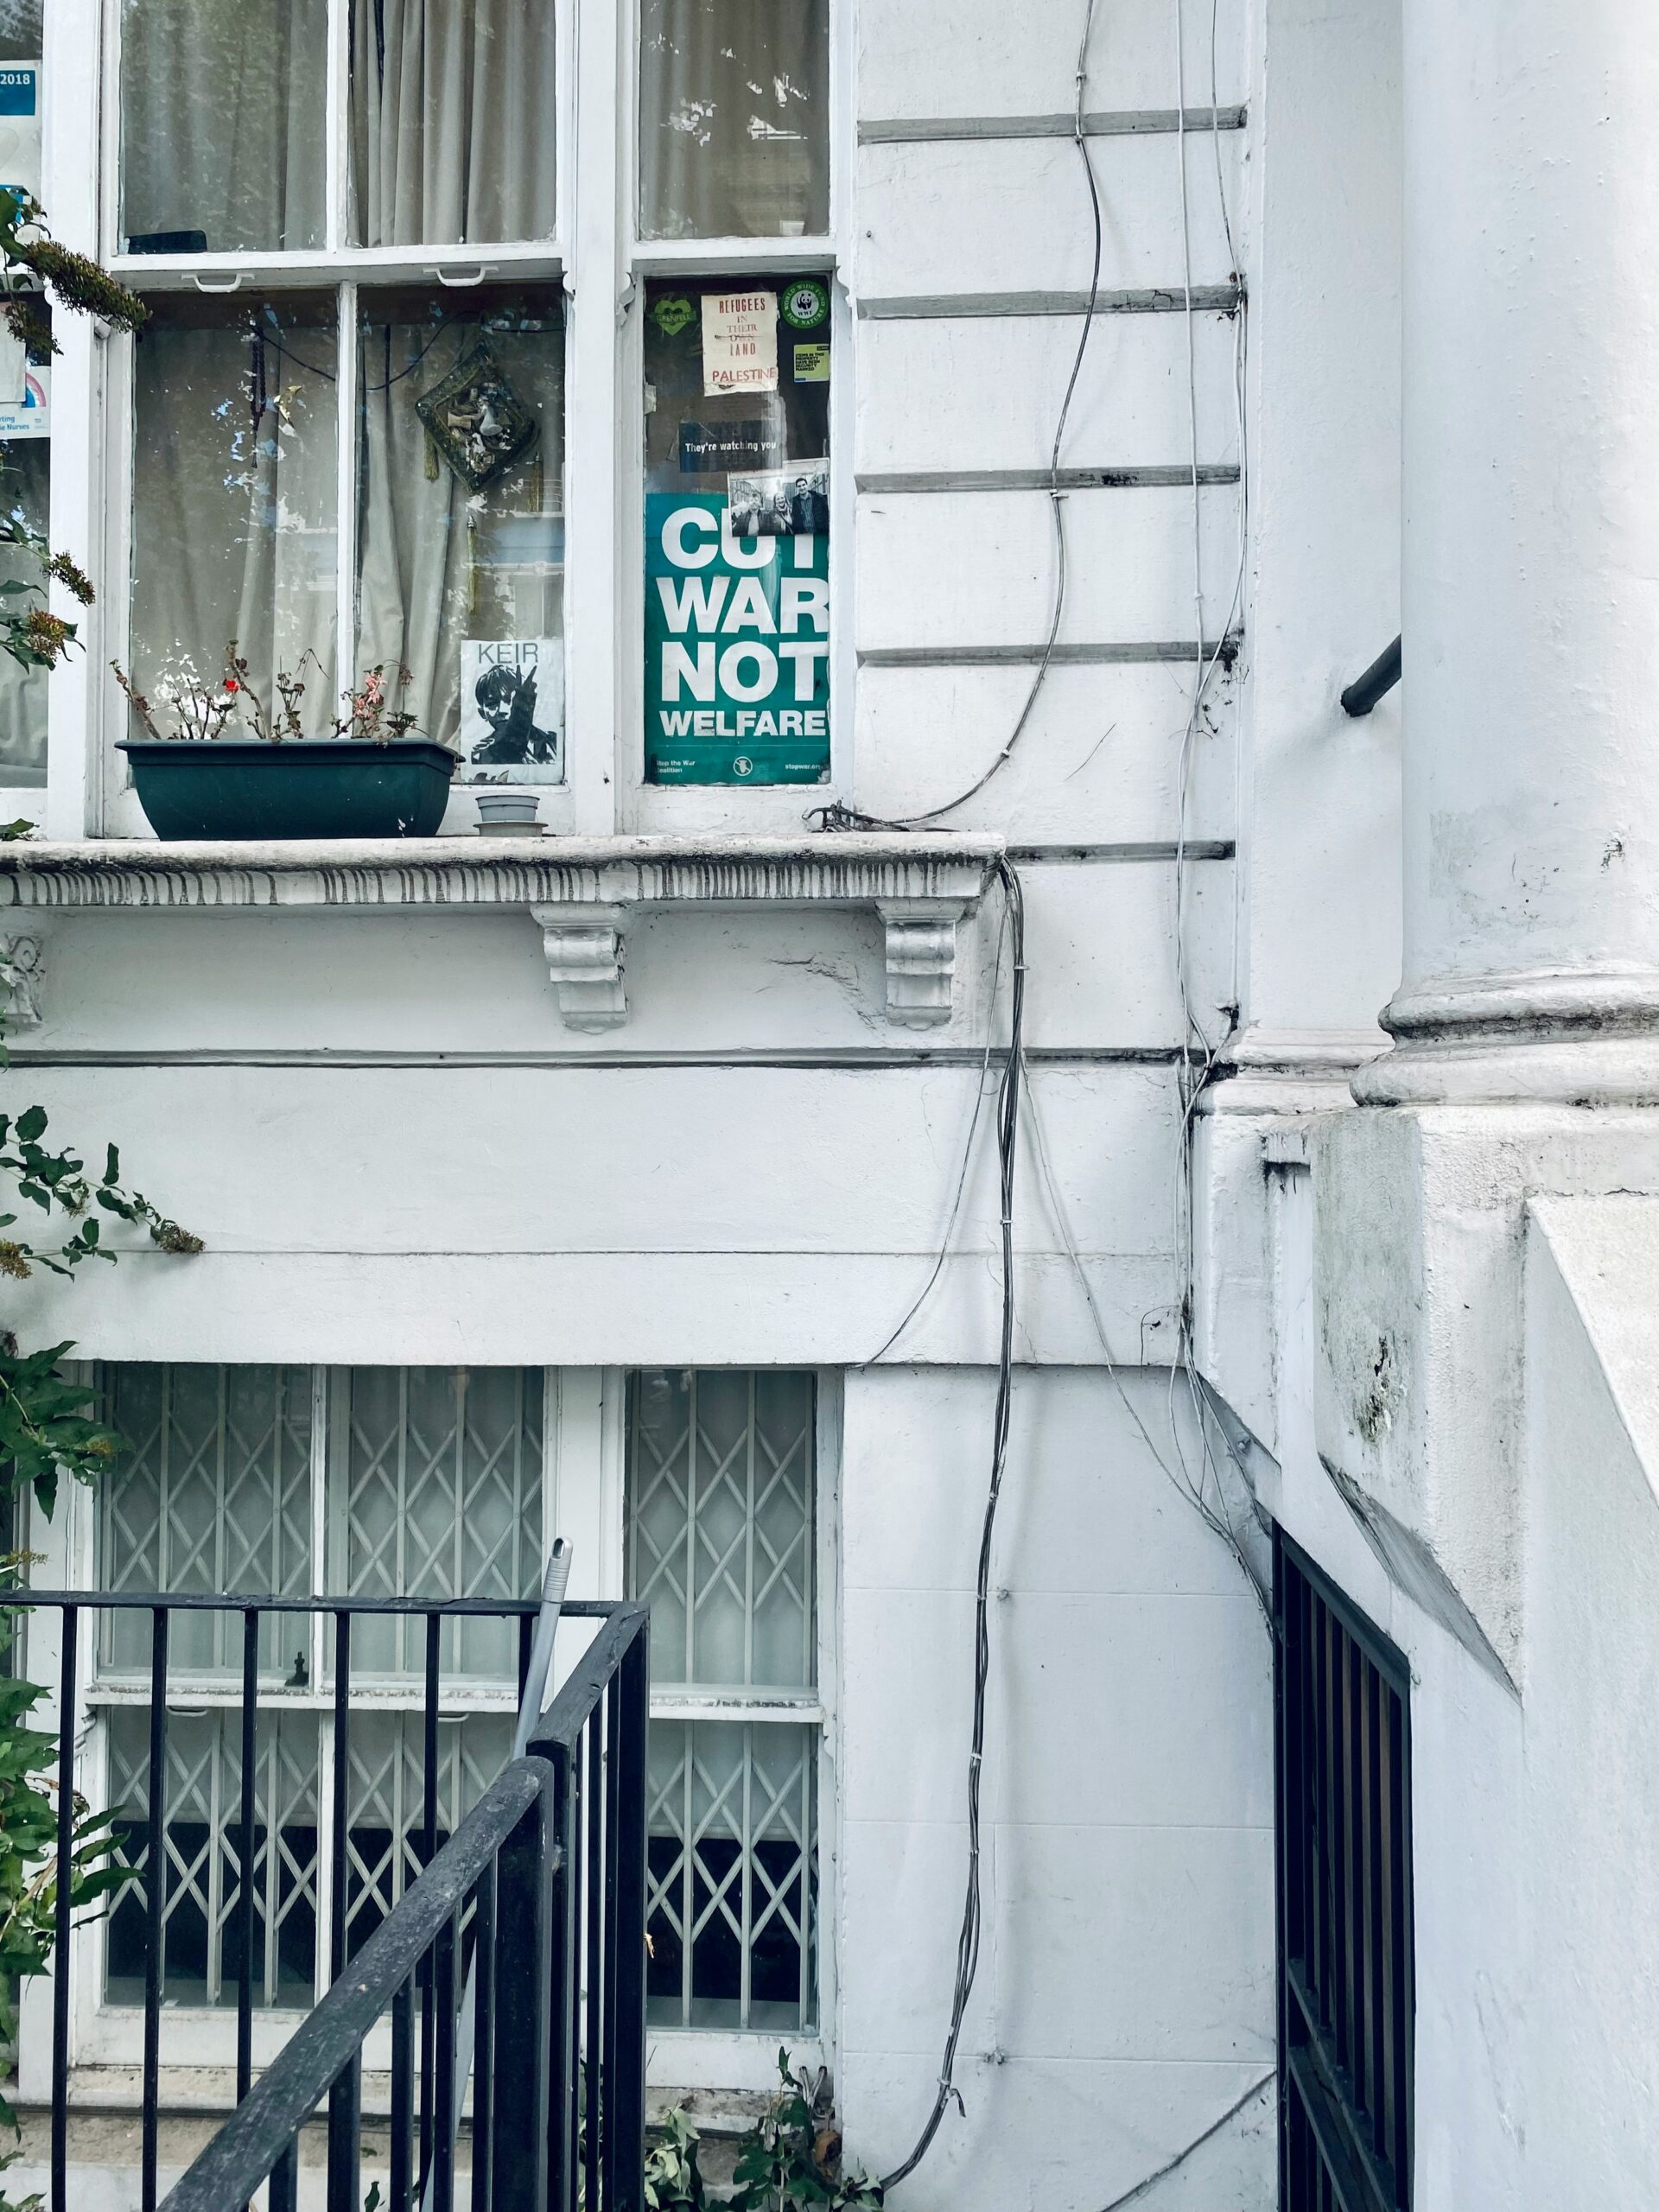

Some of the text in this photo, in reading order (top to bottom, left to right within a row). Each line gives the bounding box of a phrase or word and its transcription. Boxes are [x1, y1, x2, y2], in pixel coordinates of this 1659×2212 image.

[0, 73, 30, 85] 2018
[719, 297, 766, 314] REFUGEES
[784, 288, 796, 311] WORLD
[737, 315, 747, 323] IN
[727, 324, 758, 334] THEIR
[729, 334, 754, 342] OWN
[730, 343, 756, 356] LAND
[712, 367, 776, 382] PALESTINE
[685, 441, 777, 454] They're watching you
[656, 577, 829, 633] WAR
[478, 643, 538, 664] KEIR
[661, 641, 829, 702] NOT
[658, 710, 826, 736] WELFARE
